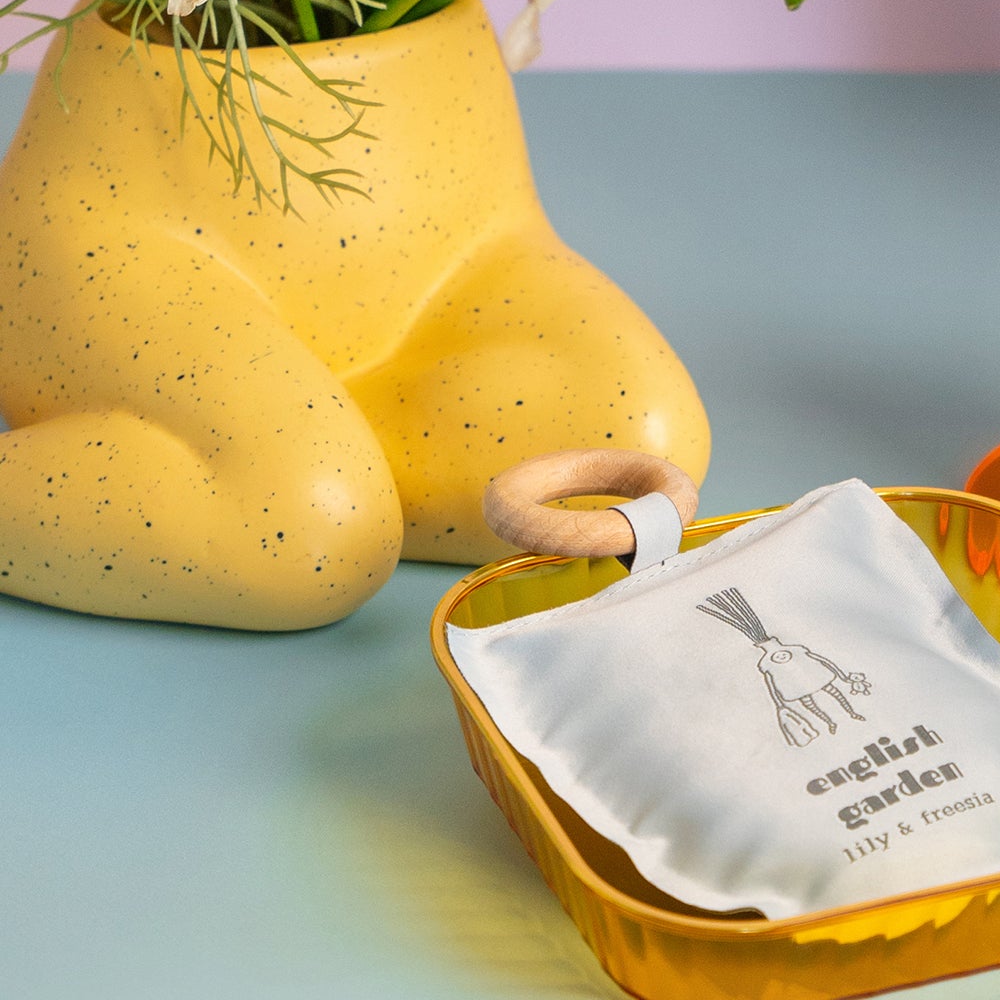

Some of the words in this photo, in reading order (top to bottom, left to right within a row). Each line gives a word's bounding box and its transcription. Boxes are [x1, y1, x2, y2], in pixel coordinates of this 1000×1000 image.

[806, 724, 944, 796] english
[837, 761, 964, 830] garden
[842, 832, 890, 864] lily
[897, 821, 914, 836] &
[920, 791, 995, 825] freesia
